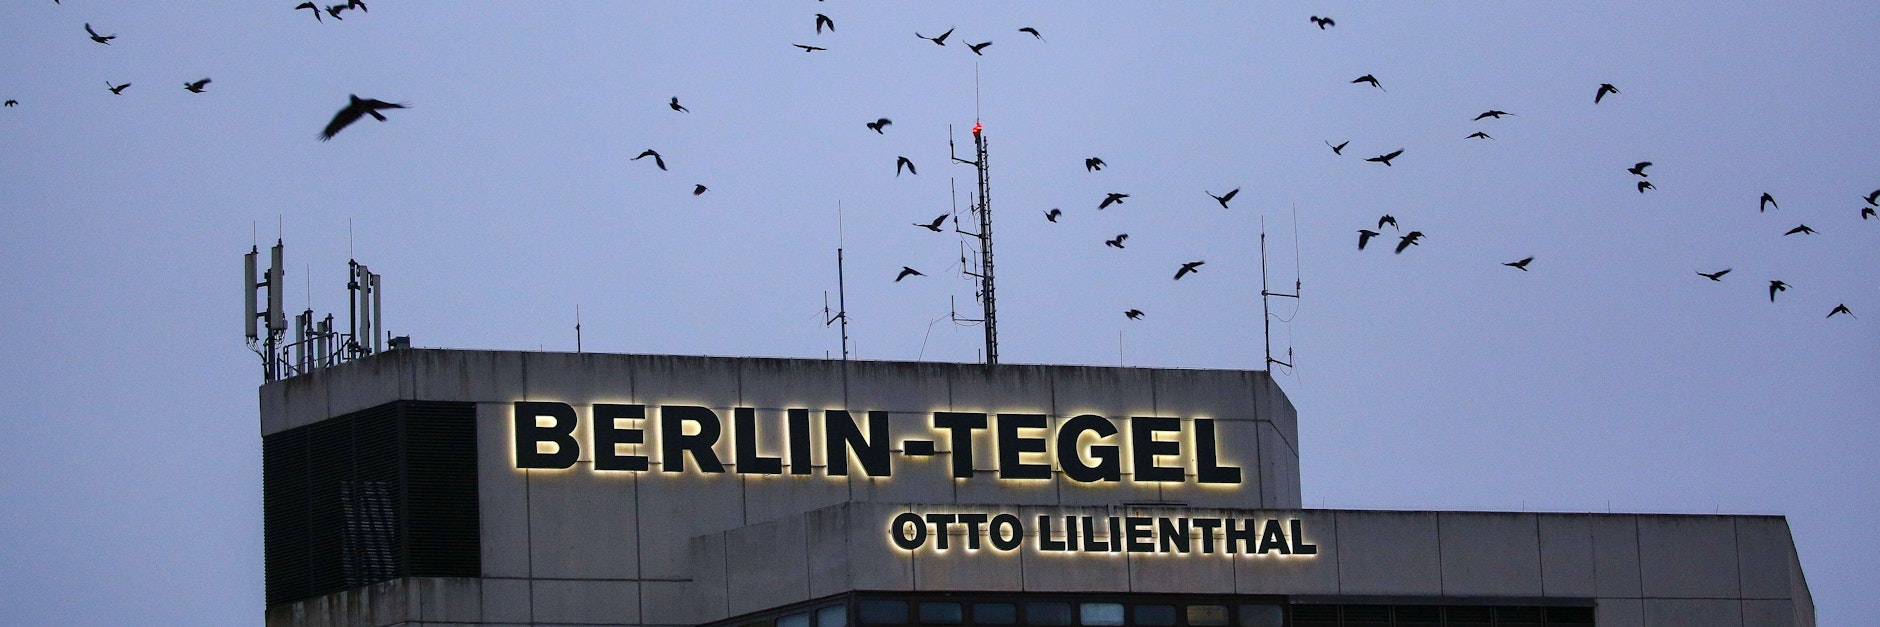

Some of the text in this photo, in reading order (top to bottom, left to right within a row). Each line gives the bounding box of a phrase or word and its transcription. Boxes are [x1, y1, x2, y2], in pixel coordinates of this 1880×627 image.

[514, 401, 1242, 485] BERLIN-TEGEL
[892, 512, 1318, 556] OTTO LILIENTHAL
